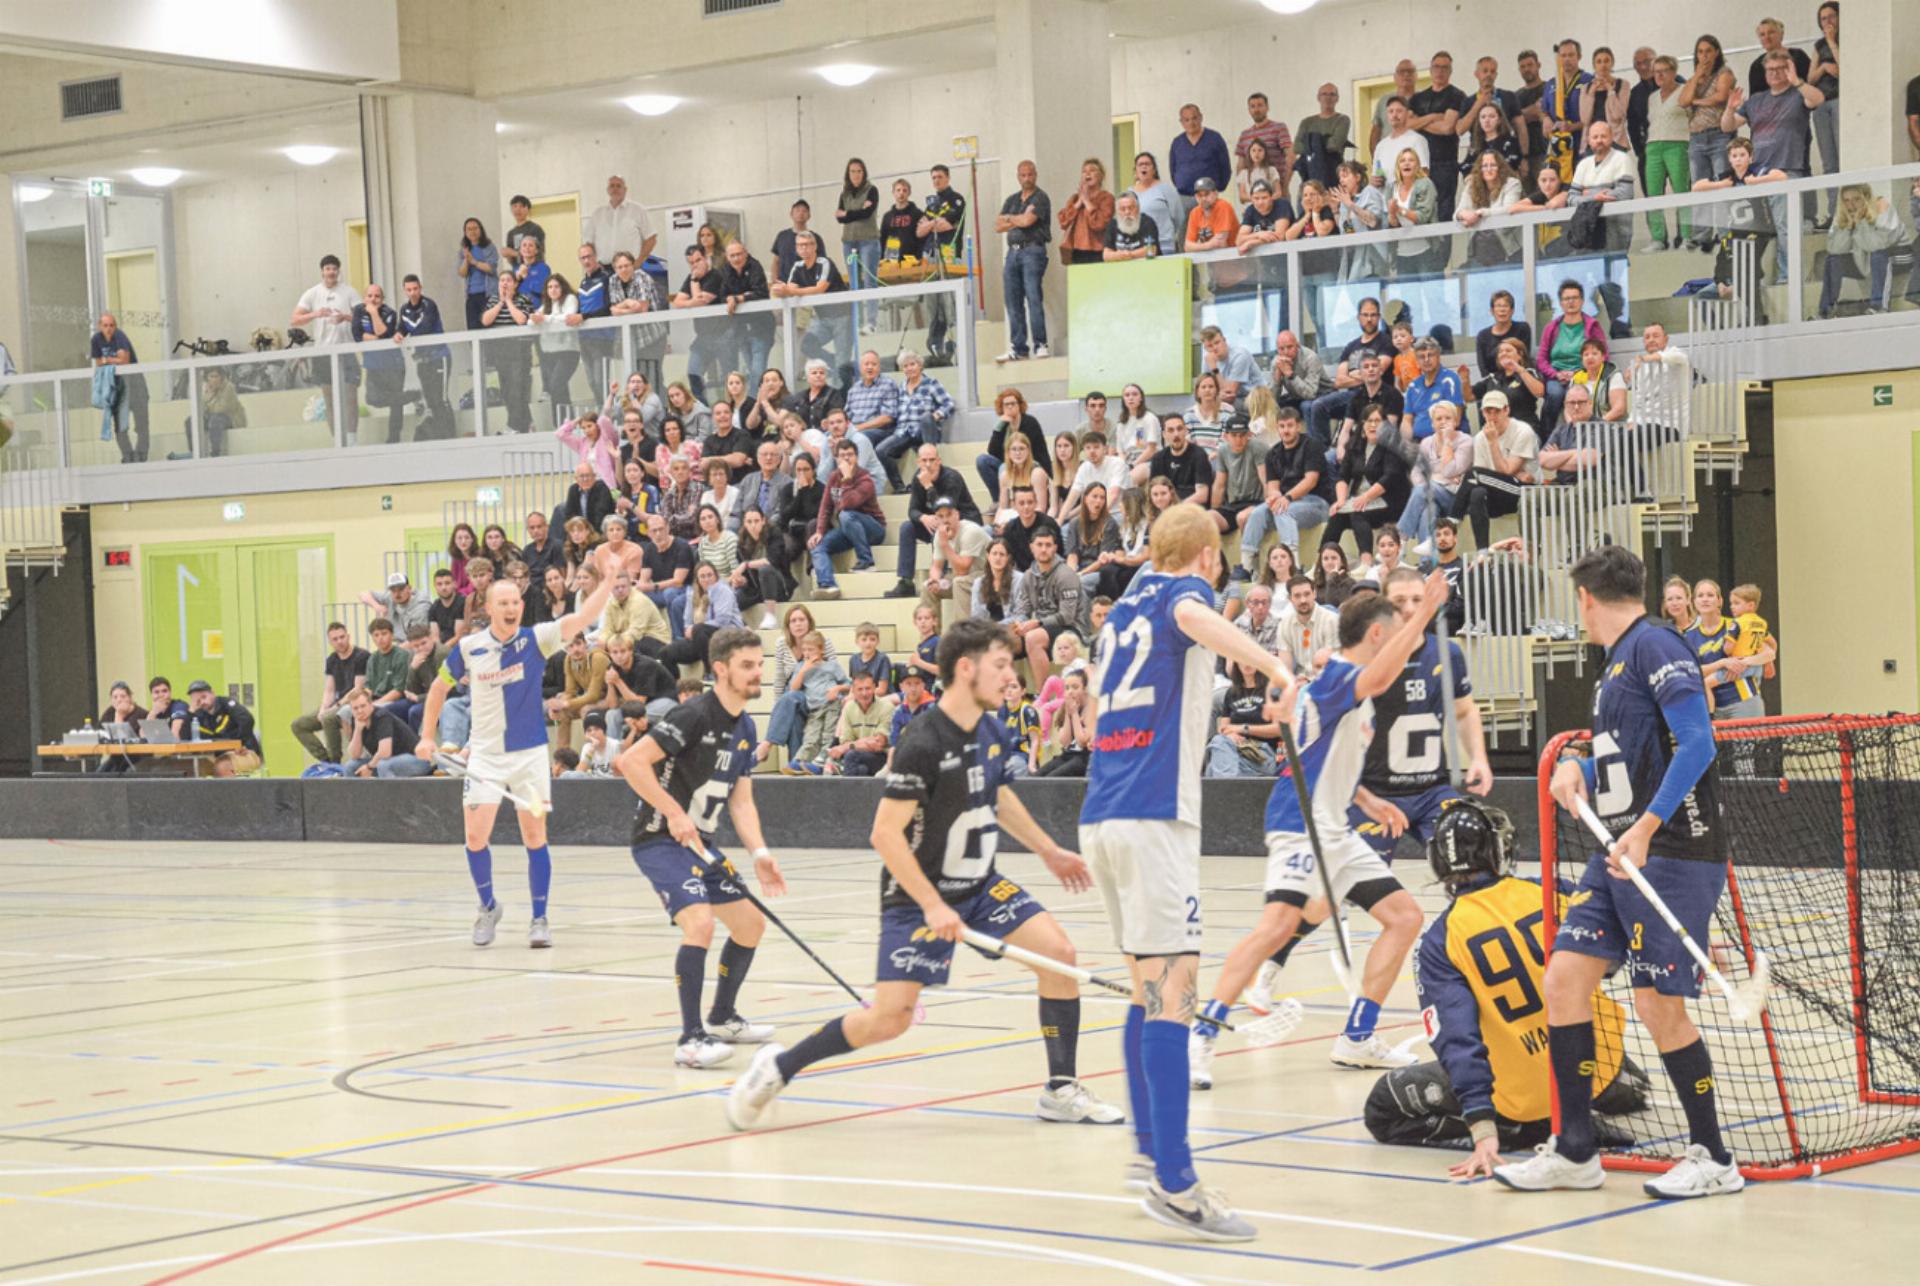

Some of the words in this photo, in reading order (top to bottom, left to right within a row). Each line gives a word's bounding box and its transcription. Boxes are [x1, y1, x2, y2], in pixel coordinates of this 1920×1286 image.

[1097, 615, 1155, 718] 22
[1405, 679, 1426, 701] 58
[1388, 713, 1441, 774] G
[714, 749, 732, 771] 70
[1685, 789, 1709, 838] ore.ch
[1286, 852, 1314, 874] 40
[988, 880, 1020, 902] 66
[1186, 896, 1199, 923] 2
[1631, 923, 1644, 950] 3
[1579, 1061, 1597, 1076] S
